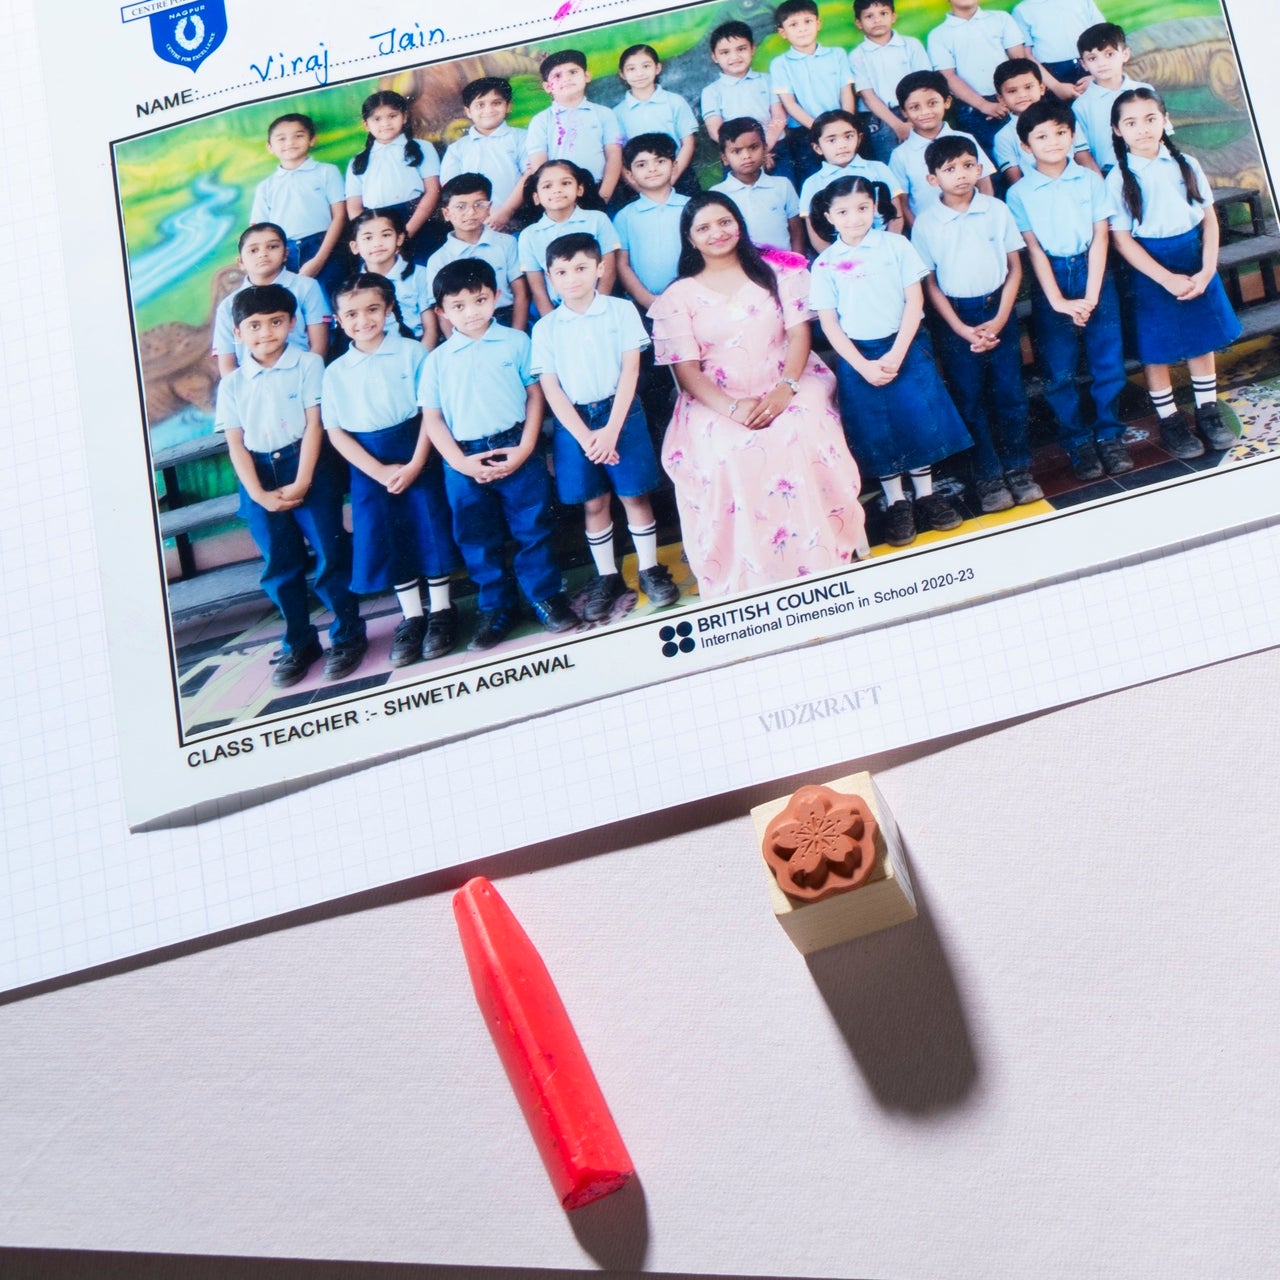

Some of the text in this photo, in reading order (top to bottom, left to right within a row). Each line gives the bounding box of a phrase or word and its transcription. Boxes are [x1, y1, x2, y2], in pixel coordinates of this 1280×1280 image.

[168, 4, 206, 20] NAGPUR
[165, 42, 181, 61] CENTRE
[192, 31, 216, 62] EXCELLENCE
[250, 22, 446, 85] Viraj Jain
[136, 89, 199, 117] NAME:
[697, 581, 860, 632] BRITISH COUNCIL
[701, 568, 974, 648] International Dimension in School 2020-23
[188, 737, 254, 767] CLASS
[260, 710, 359, 747] TEACHER
[384, 682, 471, 716] SHWETA
[476, 654, 575, 692] AGRAWAL
